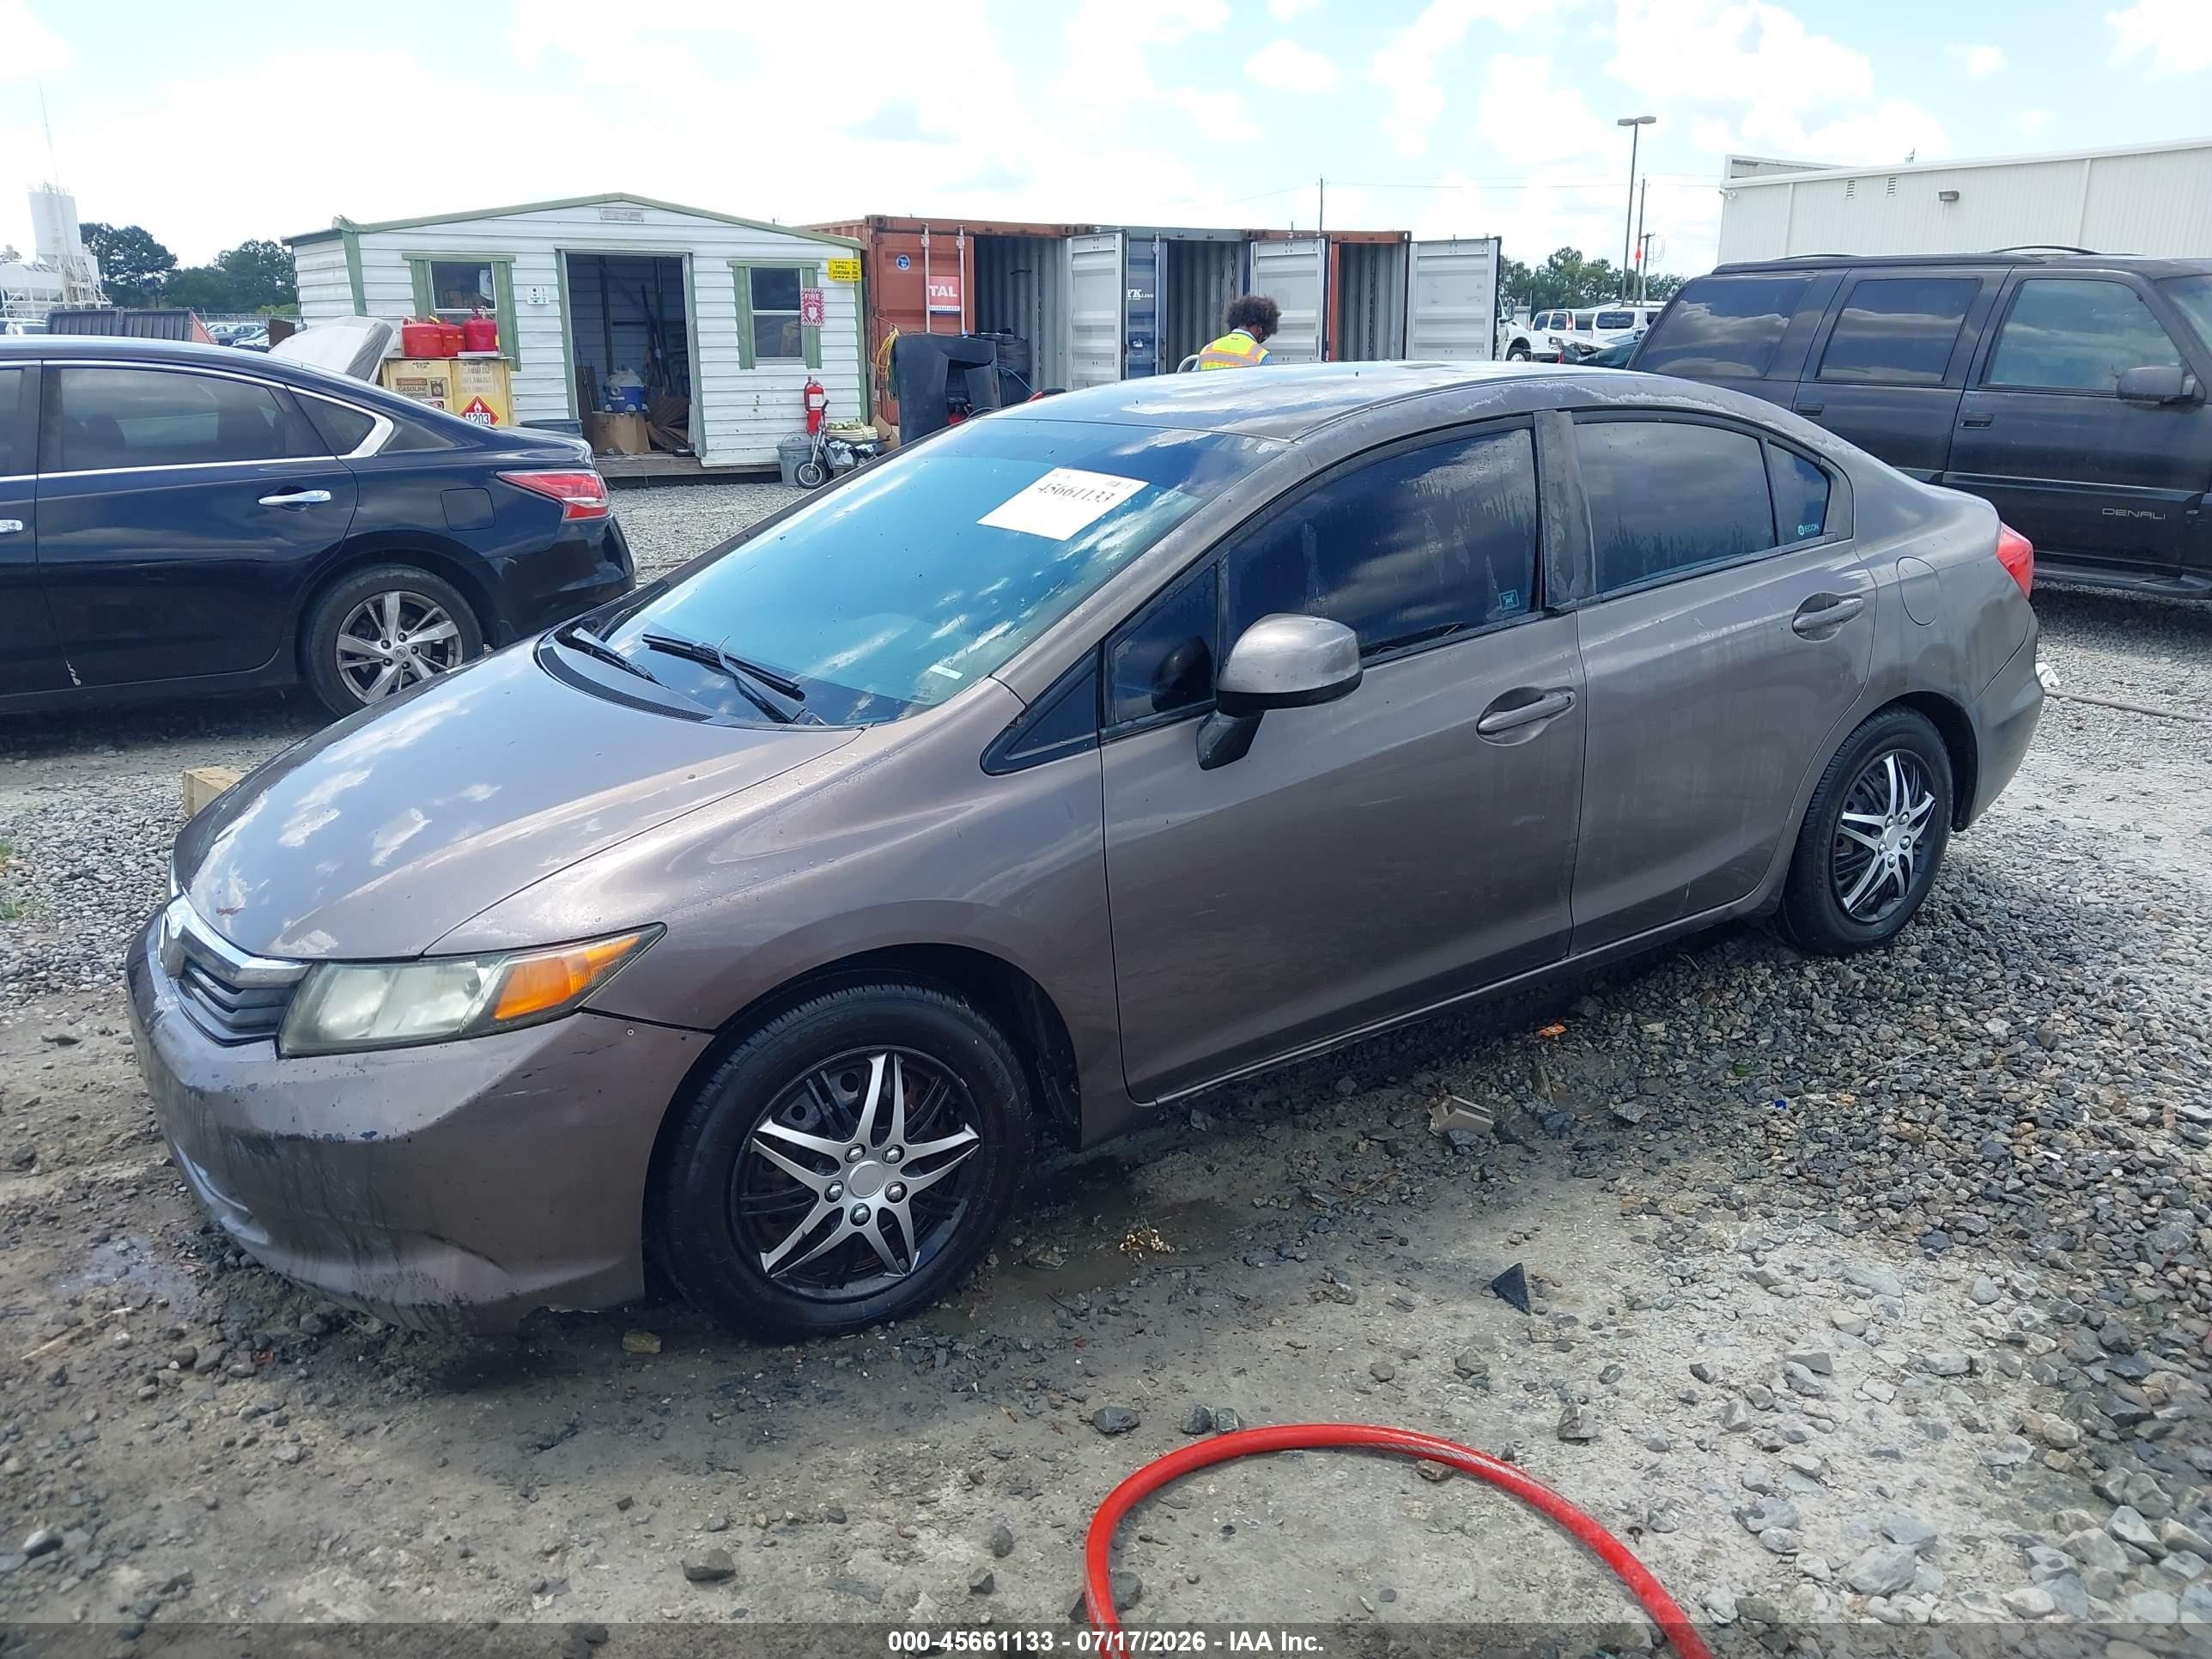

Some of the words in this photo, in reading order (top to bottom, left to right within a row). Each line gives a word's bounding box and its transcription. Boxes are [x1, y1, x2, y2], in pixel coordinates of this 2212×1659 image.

[928, 285, 958, 297] TAL
[1127, 289, 1142, 298] YK
[467, 413, 489, 425] 1203
[1037, 483, 1115, 503] 45661133
[2102, 507, 2166, 520] DENALI
